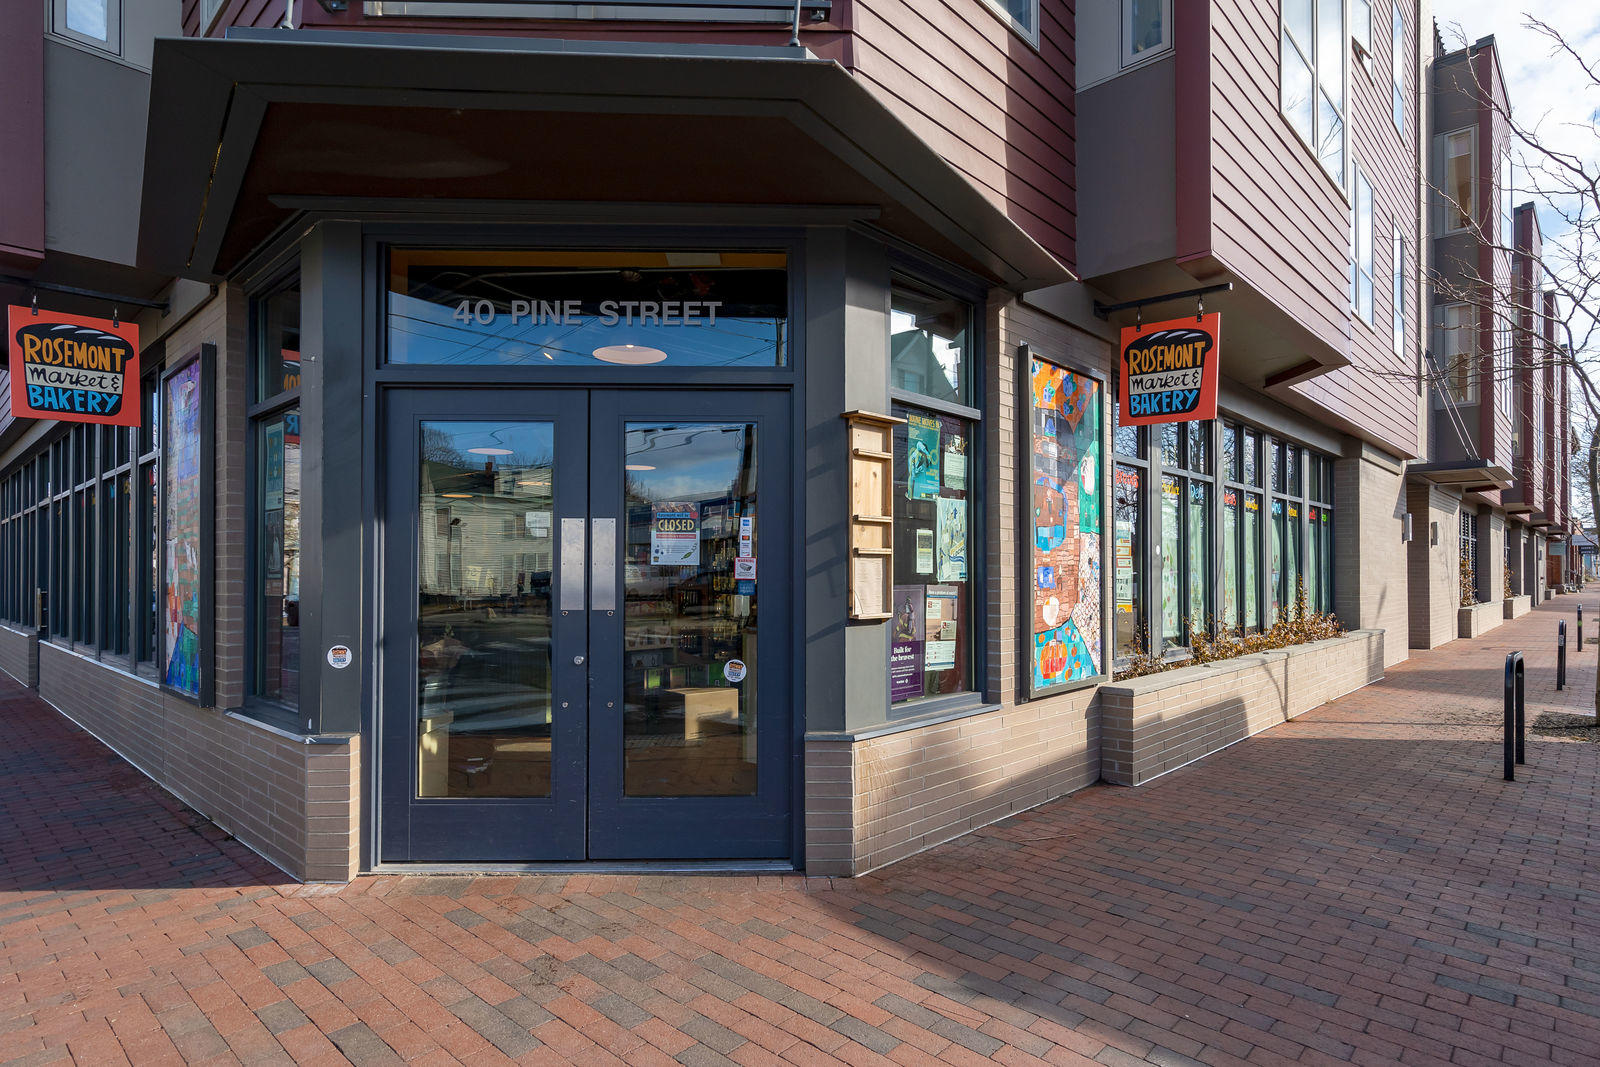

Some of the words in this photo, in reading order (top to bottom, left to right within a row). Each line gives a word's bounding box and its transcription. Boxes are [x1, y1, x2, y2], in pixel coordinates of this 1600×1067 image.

[453, 300, 495, 325] 40
[511, 300, 582, 325] PINE
[600, 301, 722, 326] STREET
[24, 334, 125, 372] ROSEMONT
[1129, 341, 1206, 375] ROSEMONT
[111, 375, 120, 391] &
[1192, 370, 1199, 386] &
[28, 385, 119, 413] BAKERY
[1130, 389, 1198, 415] BAKERY
[658, 519, 695, 531] CLOSED
